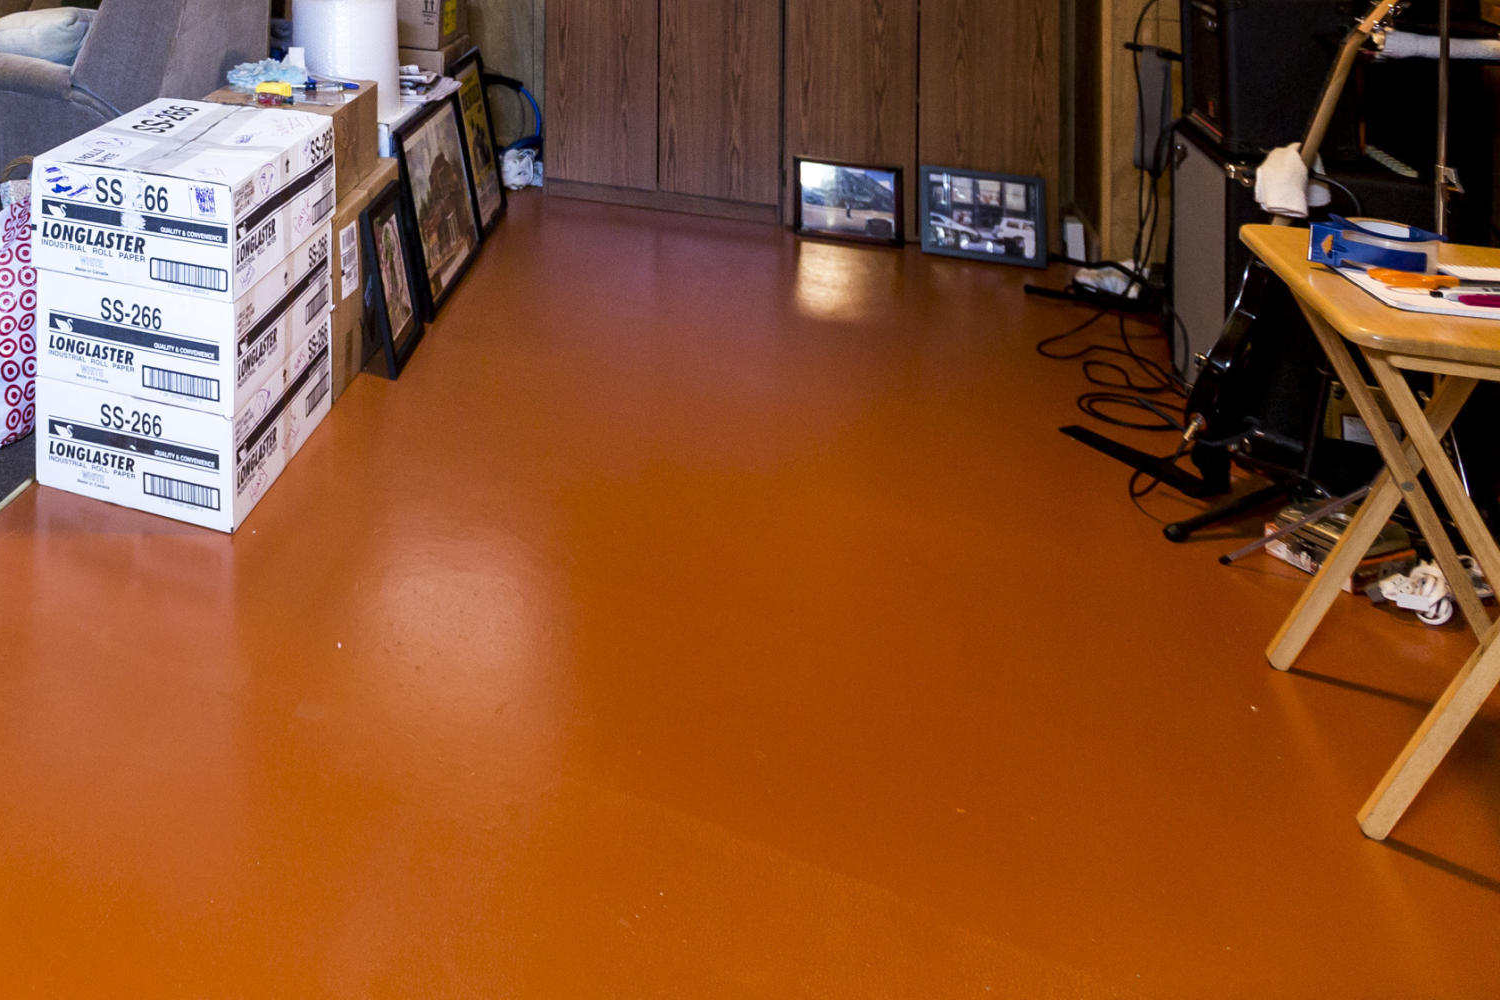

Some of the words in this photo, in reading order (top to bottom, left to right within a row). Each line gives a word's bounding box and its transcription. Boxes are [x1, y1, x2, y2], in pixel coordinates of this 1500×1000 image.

[132, 105, 200, 133] SS-266
[41, 221, 146, 255] LONGLASTER
[159, 226, 181, 236] QUALITY
[186, 231, 223, 242] CONVENIENCE
[236, 218, 276, 265] LONGLASTER
[41, 238, 87, 253] INDUSTRIAL
[92, 247, 113, 258] ROLL
[118, 252, 146, 263] PAPER
[100, 297, 162, 330] SS-266
[48, 349, 87, 363] INDUSTRIAL
[90, 358, 109, 368] ROLL
[112, 363, 135, 373] PAPER
[49, 334, 135, 366] LONGLASTER
[153, 342, 175, 353] QUALITY
[179, 346, 216, 360] CONVENIENCE
[100, 404, 163, 437] SS-266
[49, 441, 136, 473] LONGLASTER
[49, 455, 87, 470] INDUSTRIAL
[91, 464, 109, 474] ROLL
[113, 469, 136, 480] PAPER
[154, 449, 175, 460] QUALITY
[180, 454, 216, 469] CONVENIENCE
